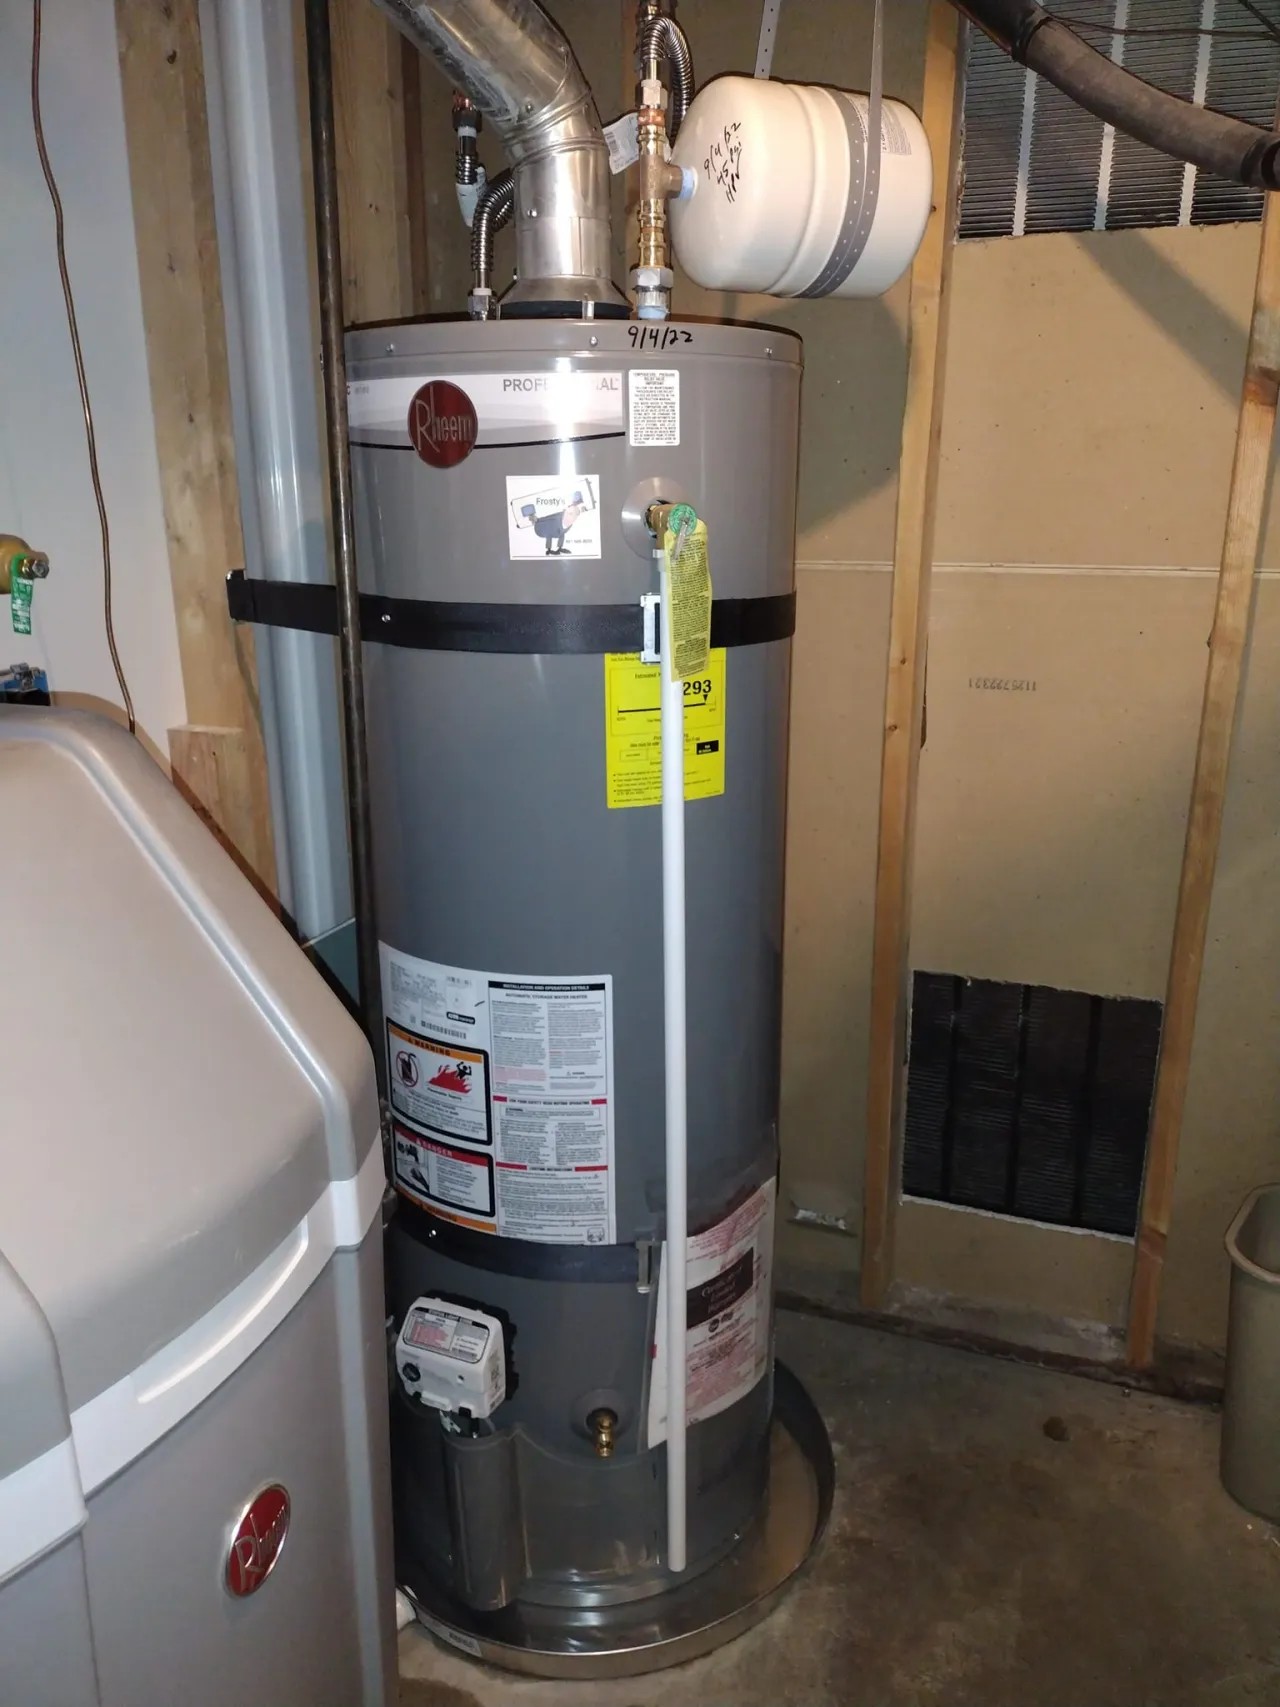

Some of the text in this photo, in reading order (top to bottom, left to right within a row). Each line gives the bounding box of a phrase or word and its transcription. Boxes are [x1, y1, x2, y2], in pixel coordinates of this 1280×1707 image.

[628, 325, 694, 350] 9/4/22
[502, 378, 619, 391] PROFAL
[415, 384, 473, 453] Rheem
[683, 679, 712, 696] 293
[234, 1504, 288, 1593] Rheem
